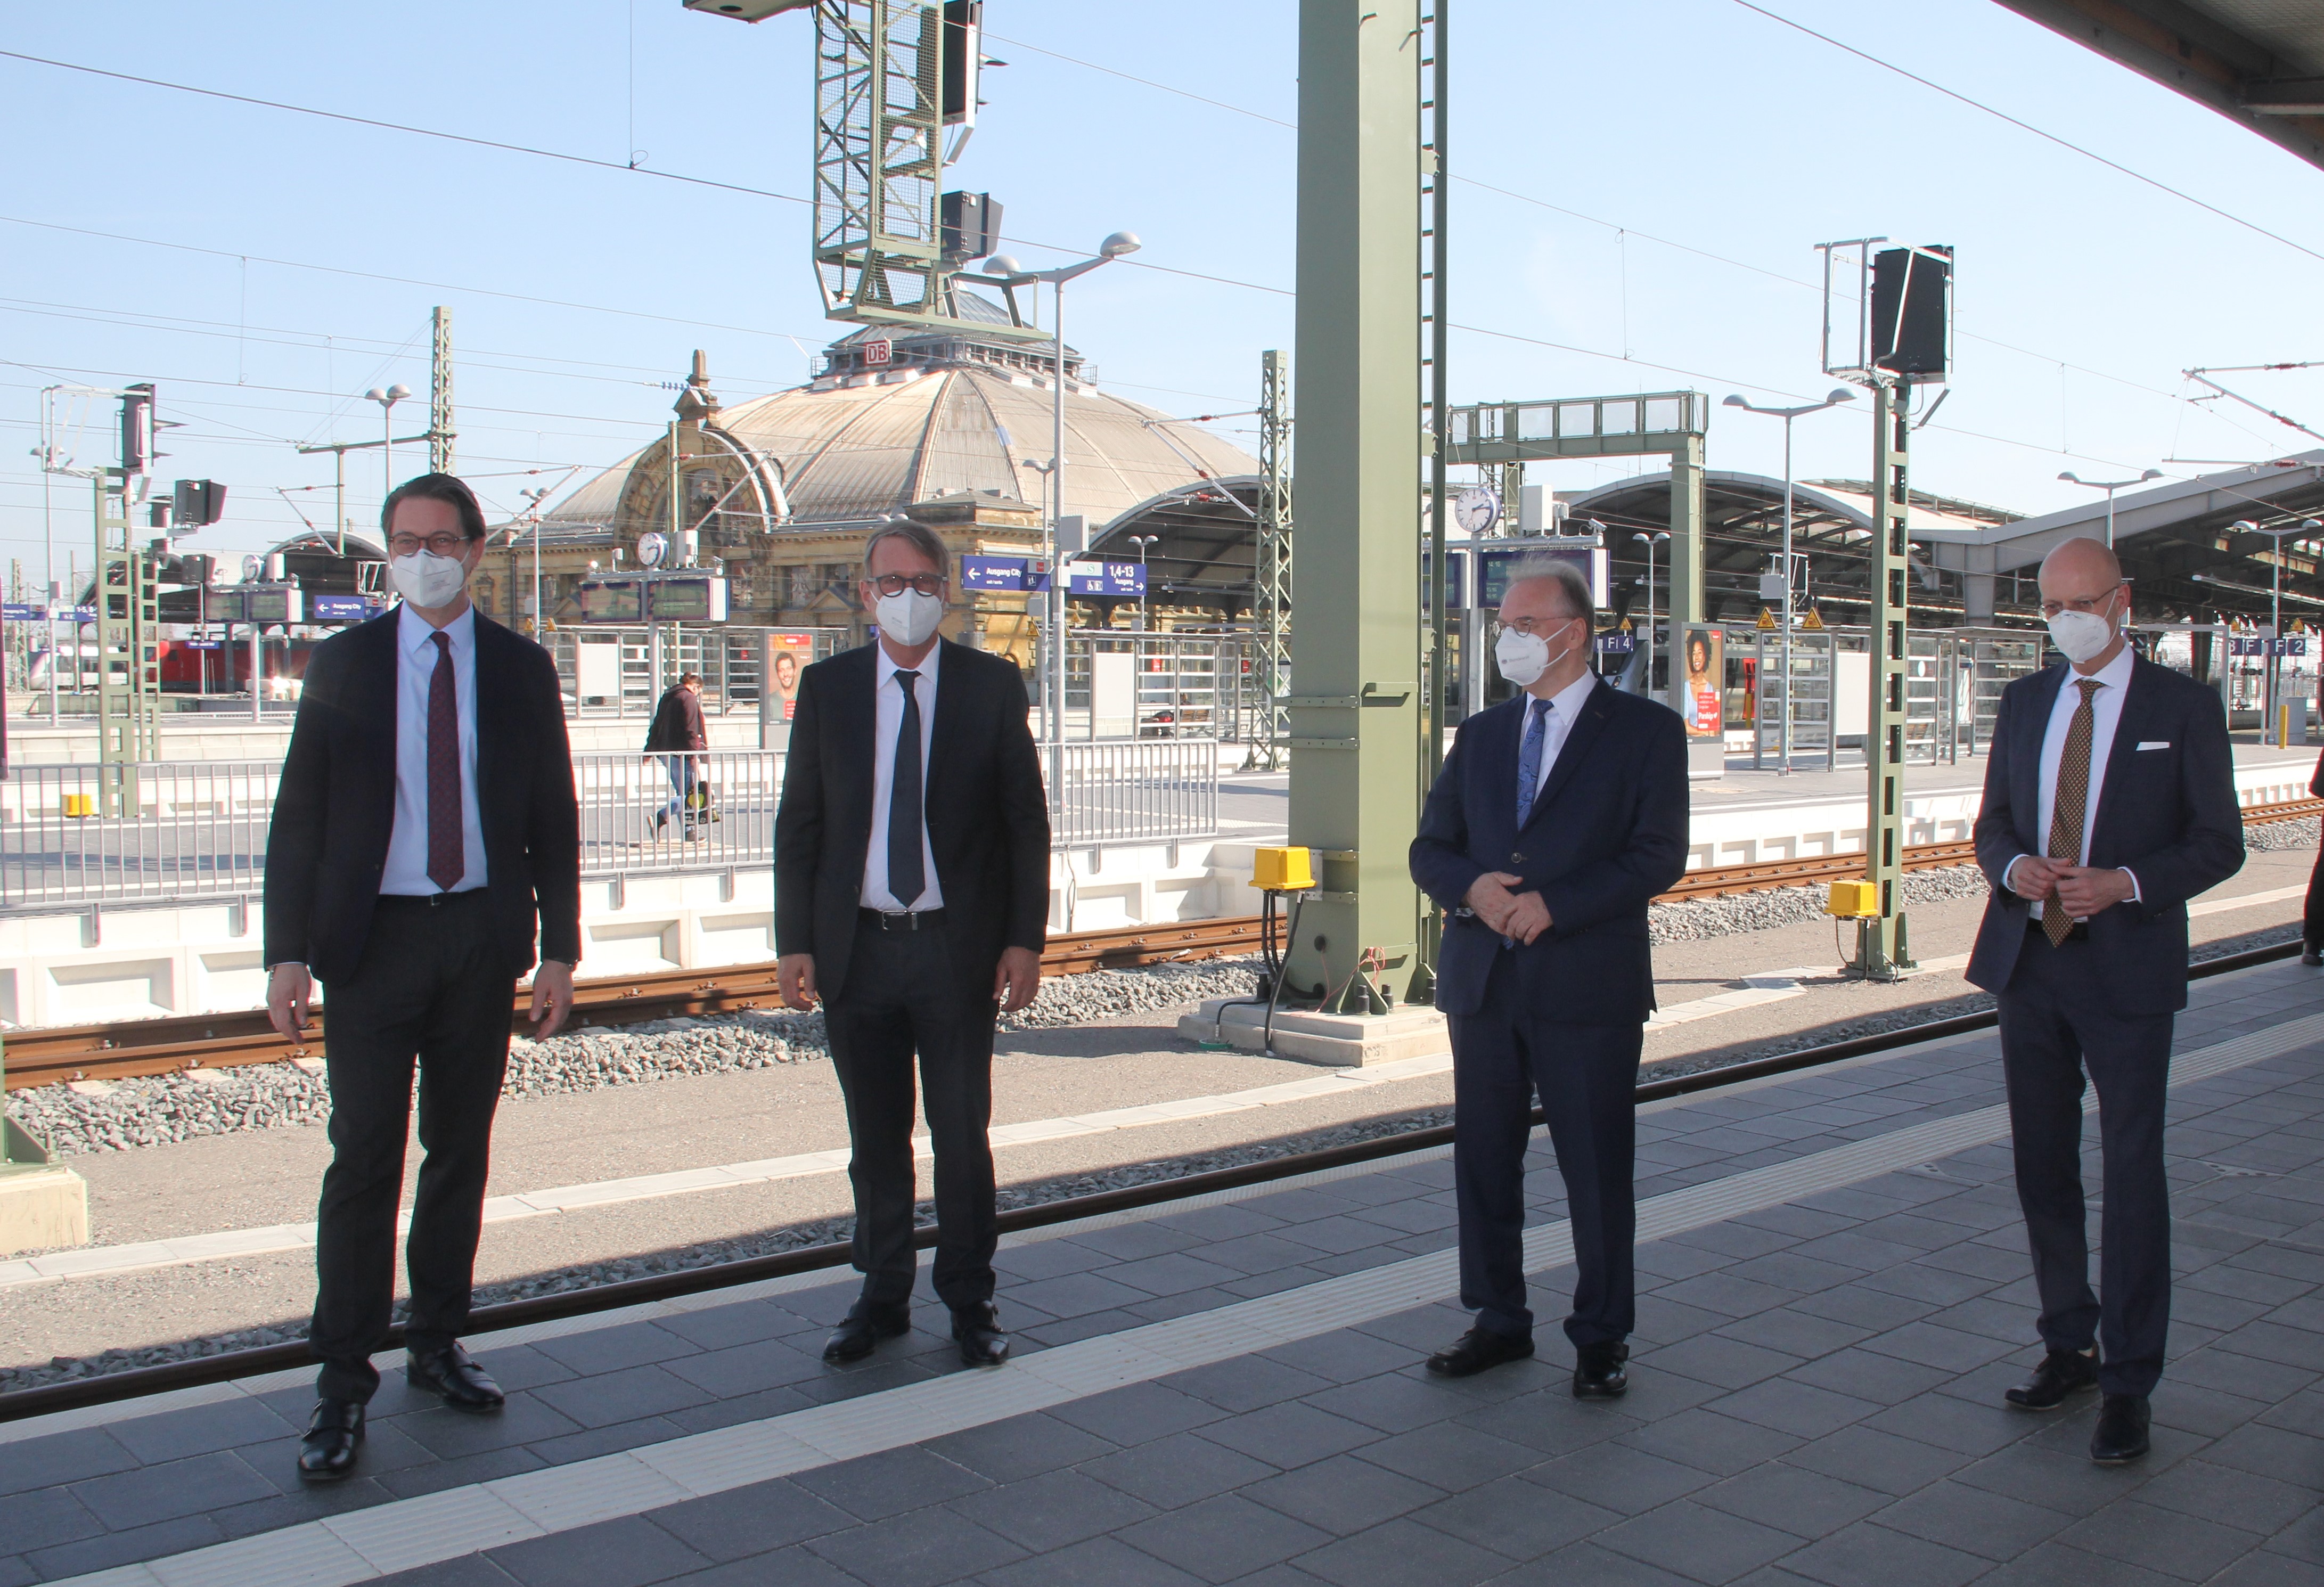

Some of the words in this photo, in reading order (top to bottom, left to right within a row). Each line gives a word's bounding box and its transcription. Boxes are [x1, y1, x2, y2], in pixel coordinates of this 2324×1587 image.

[868, 345, 887, 362] DB
[986, 567, 1010, 577] Ausgang
[1011, 568, 1022, 578] City
[1109, 565, 1134, 578] 1,4-13
[1608, 637, 1615, 649] F
[1623, 637, 1630, 649] 4
[2246, 640, 2254, 652] F
[2275, 640, 2284, 653] F
[2294, 640, 2304, 653] 2
